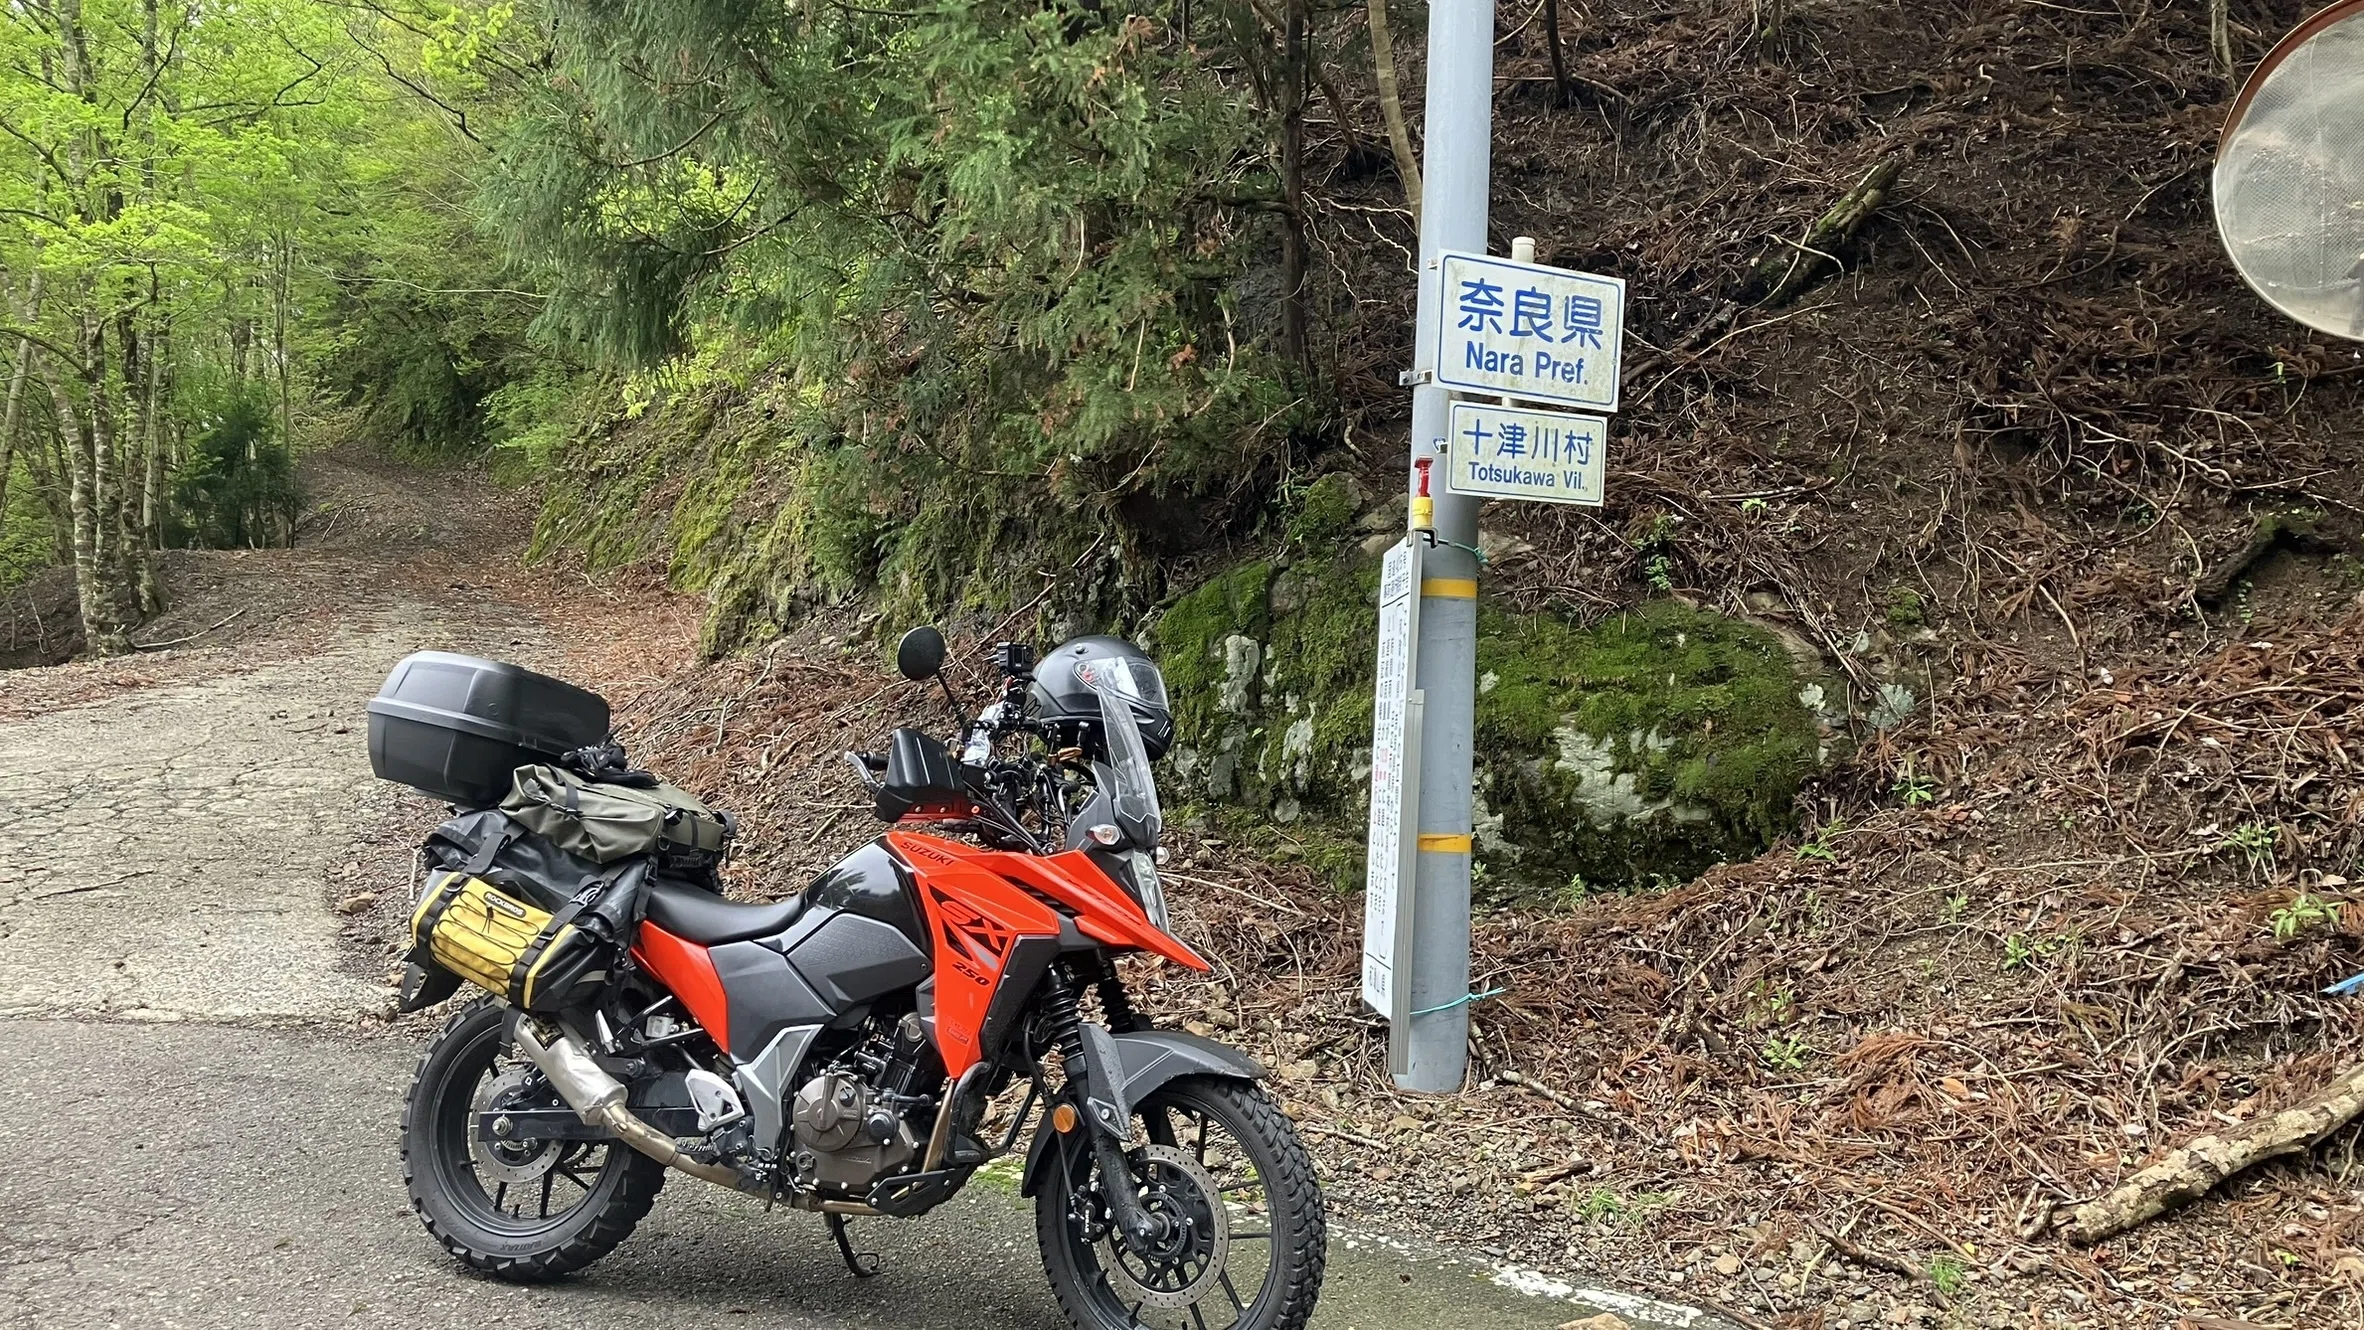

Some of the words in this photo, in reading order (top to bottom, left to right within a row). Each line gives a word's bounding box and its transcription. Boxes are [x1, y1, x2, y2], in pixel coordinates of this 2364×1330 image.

[1458, 277, 1603, 350] 奈良県
[1465, 340, 1524, 376] Nara
[1535, 351, 1588, 385] Pref.
[1462, 418, 1593, 465] 十津川村
[1468, 461, 1555, 487] Totsukawa
[1563, 470, 1587, 491] Vil.
[900, 841, 954, 866] SUZUKI
[952, 961, 991, 986] 250
